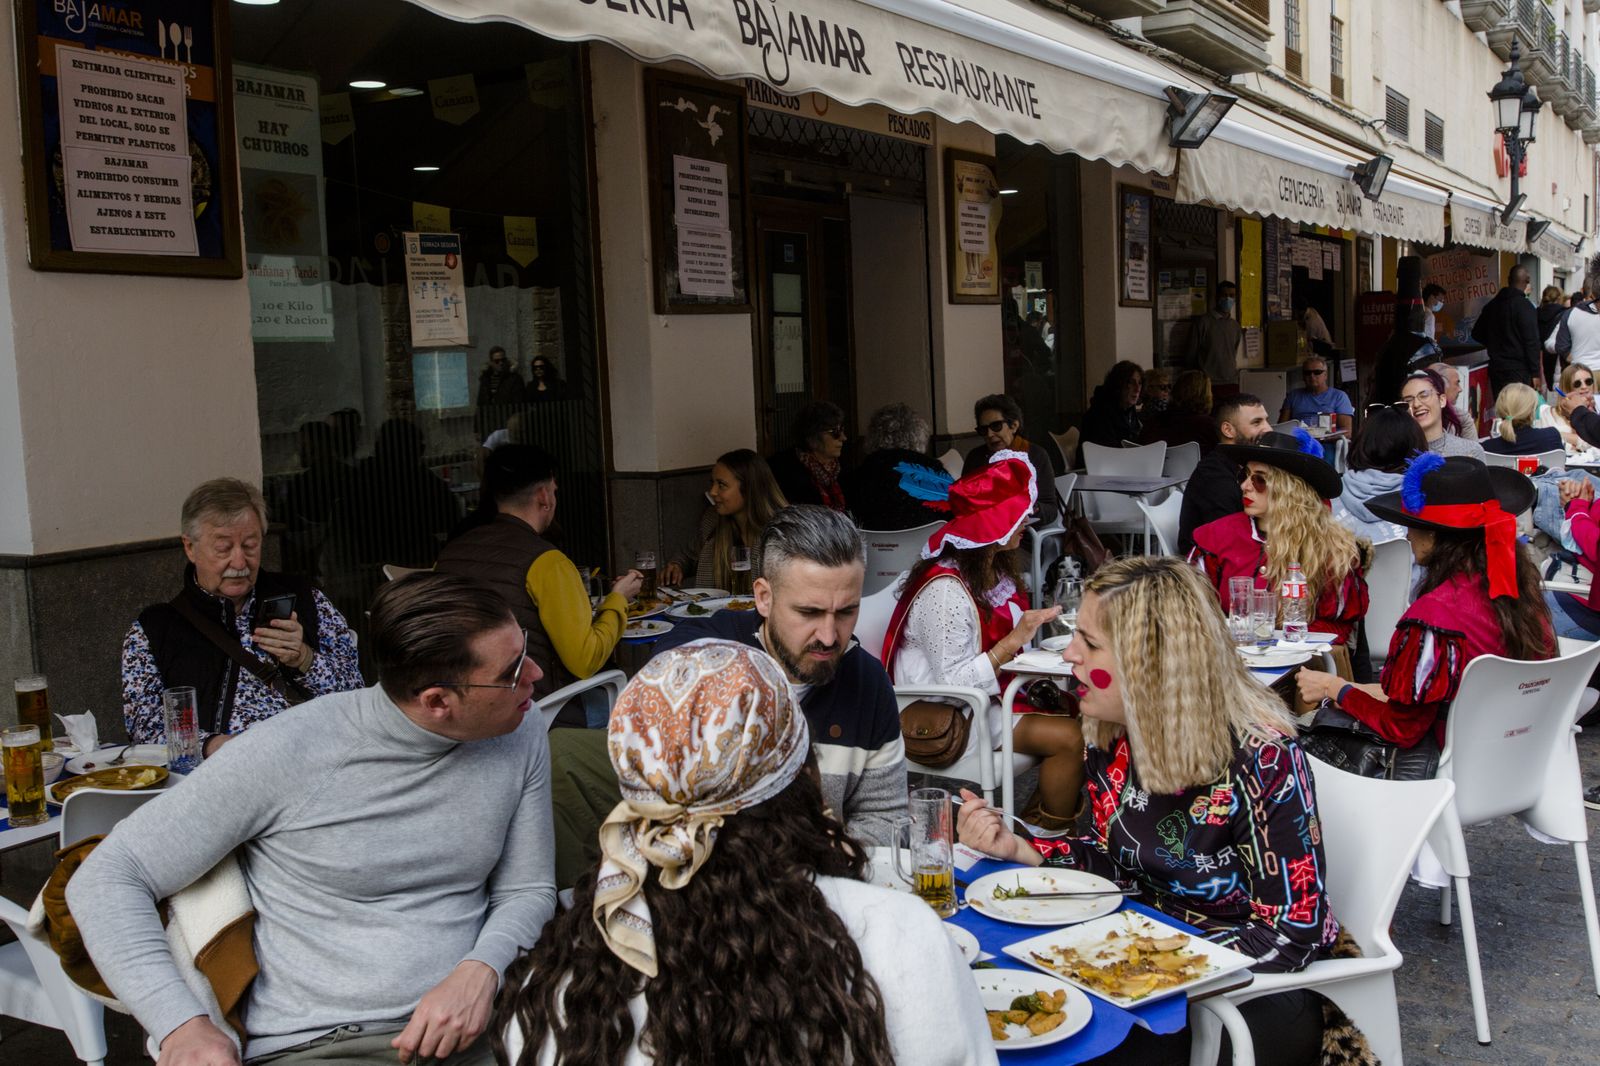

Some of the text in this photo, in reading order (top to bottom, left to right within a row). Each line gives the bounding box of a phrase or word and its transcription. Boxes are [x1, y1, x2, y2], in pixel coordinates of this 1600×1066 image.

[54, 0, 143, 33] BAJAMAR
[737, 0, 1041, 120] BAJAMAR RESTAURANTE
[72, 59, 121, 76] ESTIMADA
[124, 69, 176, 85] CLIENTELA:
[80, 84, 165, 106] PROHIBIDO SACAR
[235, 79, 305, 102] BAJAMAR
[745, 79, 800, 111] MARISCOS
[73, 99, 176, 122] VIDRIOS AL EXTERIOR
[79, 115, 170, 135] DEL LOCAL, SOLO SE
[258, 120, 289, 137] HAY
[888, 113, 930, 140] PESCADOS
[76, 131, 176, 152] PERMITEN PLASTICOS
[242, 136, 309, 157] CHURROS
[104, 157, 149, 169] BAJAMAR
[76, 170, 179, 187] PROHIBIDO CONSUMIR
[77, 189, 181, 205] ALIMENTOS Y BEBIDAS
[1279, 175, 1325, 209] CERVECERÍA
[96, 208, 166, 220] AJENOS A ESTE
[89, 225, 175, 238] ESTABLECIMIENTO
[1475, 264, 1489, 280] DE
[1467, 280, 1497, 300] FRITO
[287, 301, 314, 311] Kilo
[285, 314, 328, 325] Racion
[1518, 678, 1551, 690] Cruzcampo
